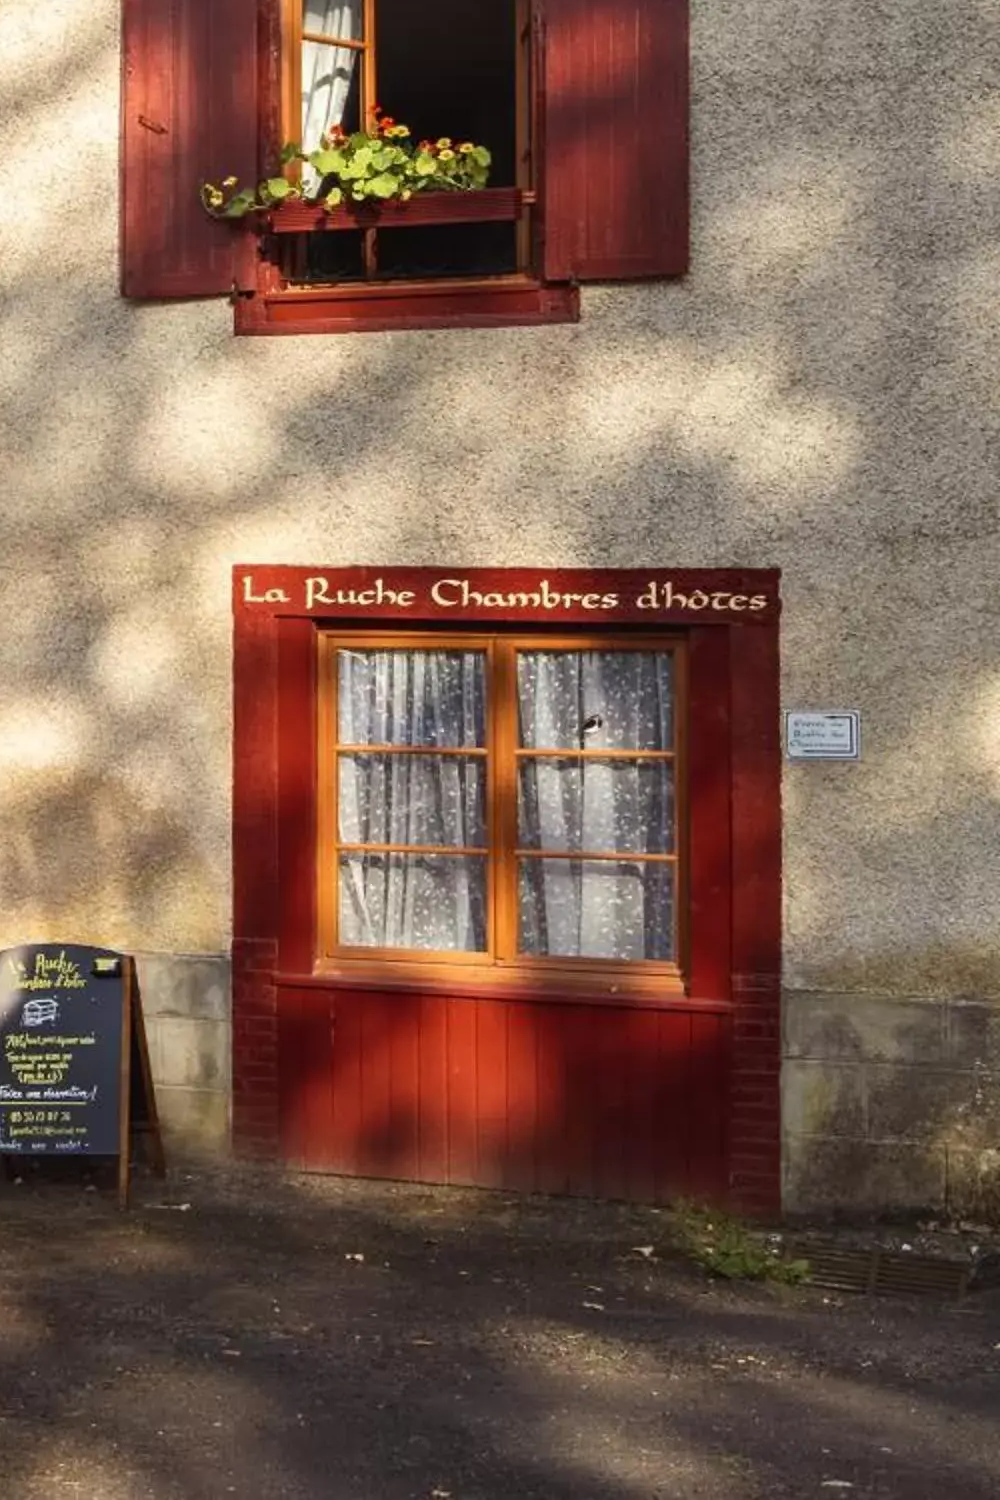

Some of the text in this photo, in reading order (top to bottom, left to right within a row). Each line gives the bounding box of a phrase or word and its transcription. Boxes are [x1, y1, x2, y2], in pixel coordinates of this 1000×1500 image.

[242, 575, 291, 603] La
[305, 576, 416, 610] Ruche
[431, 579, 619, 609] Chambres
